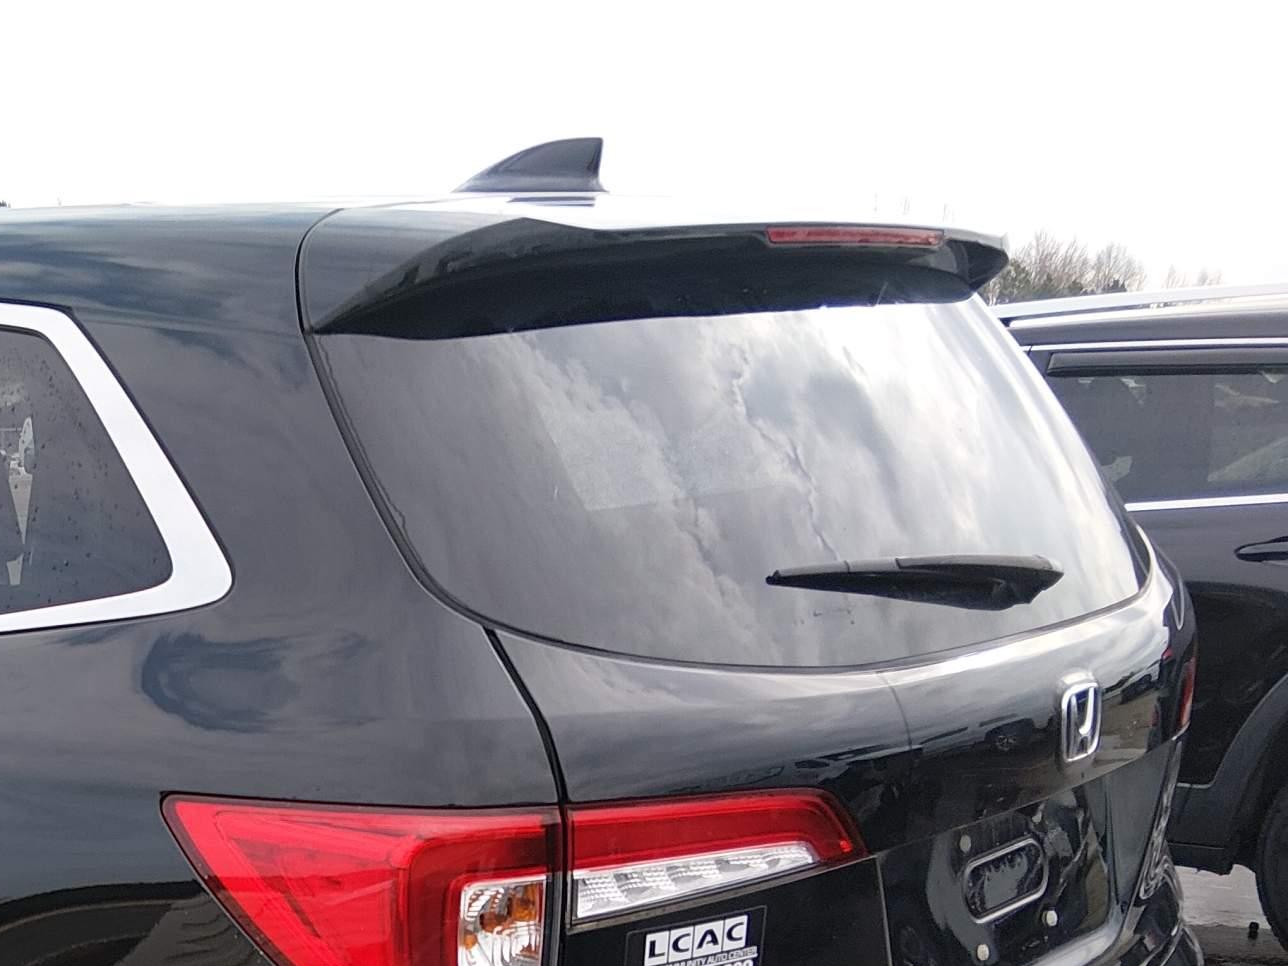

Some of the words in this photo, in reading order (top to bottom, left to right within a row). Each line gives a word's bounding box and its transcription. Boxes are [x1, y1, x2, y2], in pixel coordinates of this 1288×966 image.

[646, 919, 747, 961] LCAC
[707, 952, 728, 964] AUTO
[728, 946, 758, 960] CENTER
